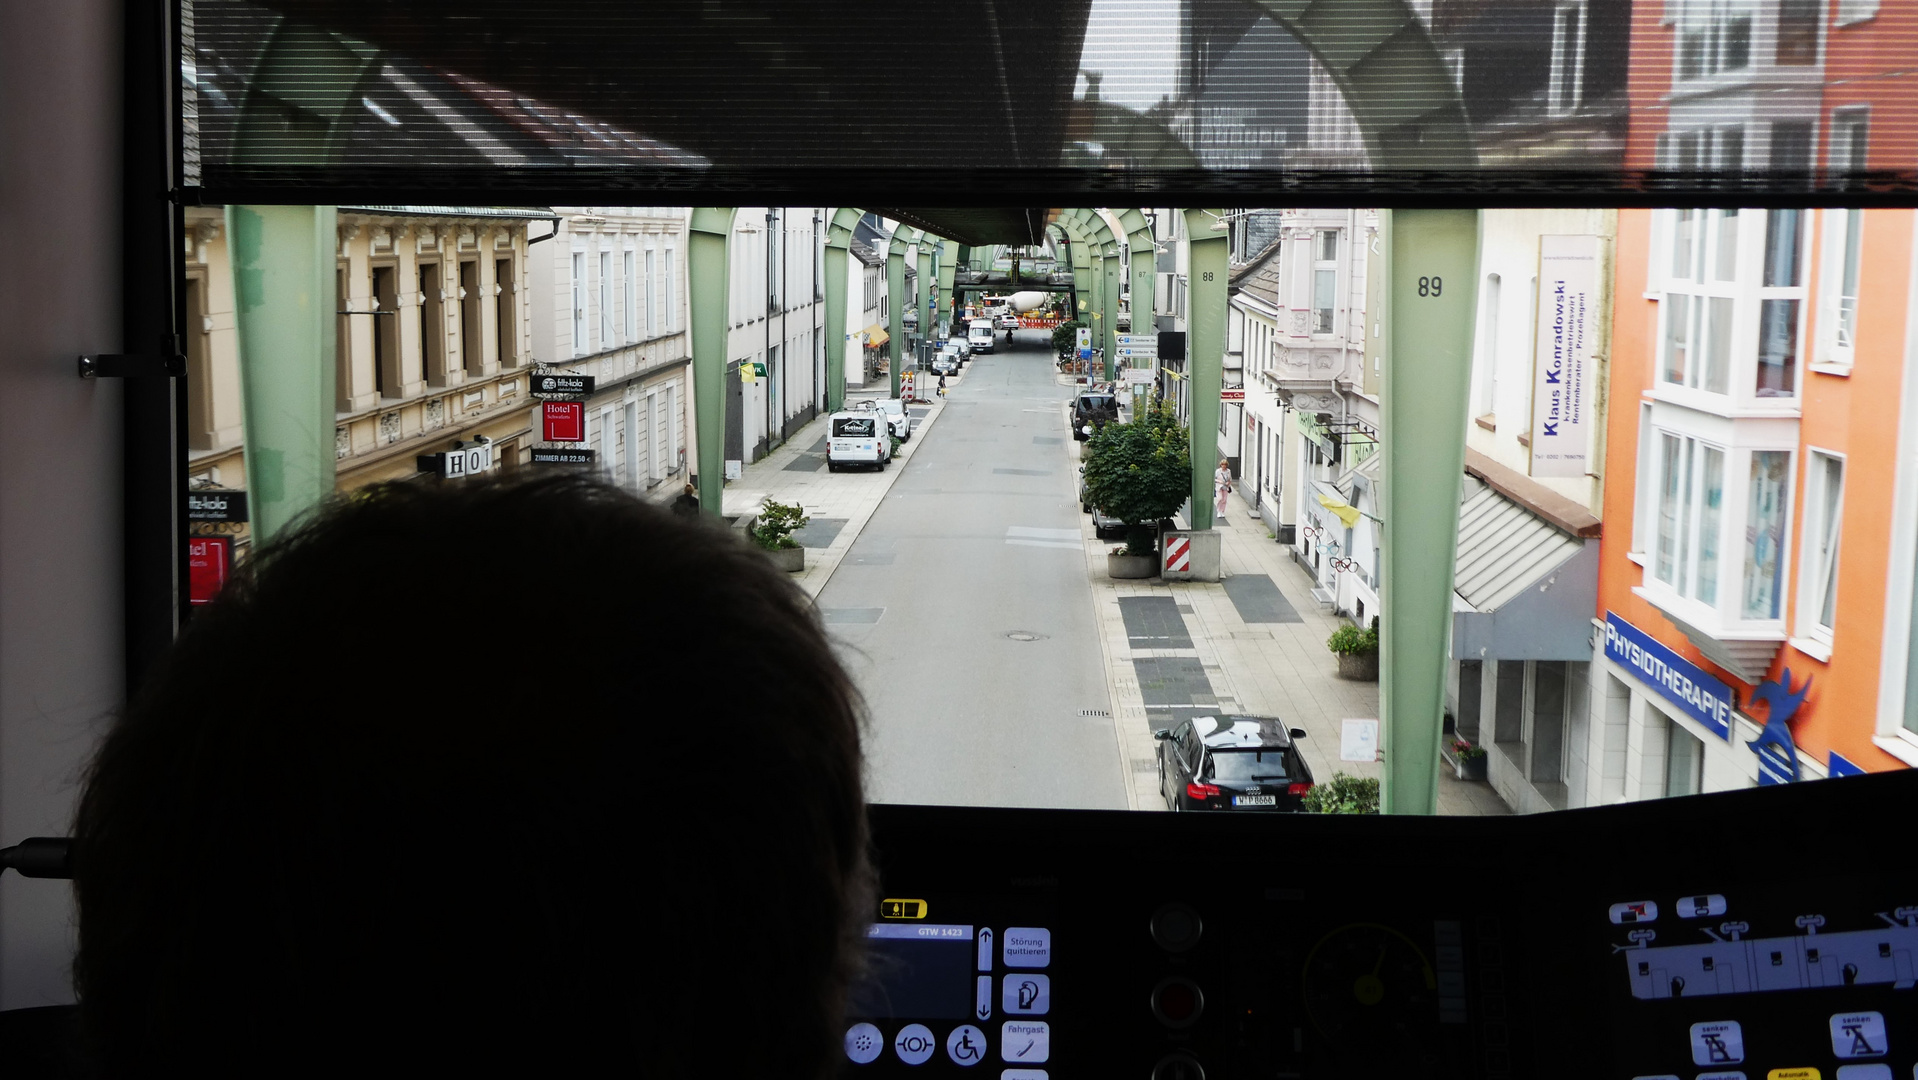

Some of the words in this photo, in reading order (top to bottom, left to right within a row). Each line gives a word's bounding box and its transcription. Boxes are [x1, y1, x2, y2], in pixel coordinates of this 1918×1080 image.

[1202, 271, 1214, 282] 88
[1417, 276, 1443, 298] 89
[1546, 280, 1566, 384] Konradowski
[1572, 359, 1583, 424] Rentenberater
[547, 404, 570, 413] Hotel
[1543, 389, 1561, 436] Klaus
[535, 454, 559, 462] ZIMMER
[569, 455, 586, 463] 22,50
[190, 542, 206, 555] tel
[1605, 621, 1730, 728] PHYSIOTHERAPIE
[918, 928, 939, 936] GTW
[941, 928, 963, 937] 1423
[1010, 937, 1043, 947] Störung
[1006, 947, 1047, 956] quittieren
[1843, 1016, 1871, 1024] senken
[1008, 1025, 1045, 1035] Fahrgast
[1702, 1025, 1729, 1033] senken
